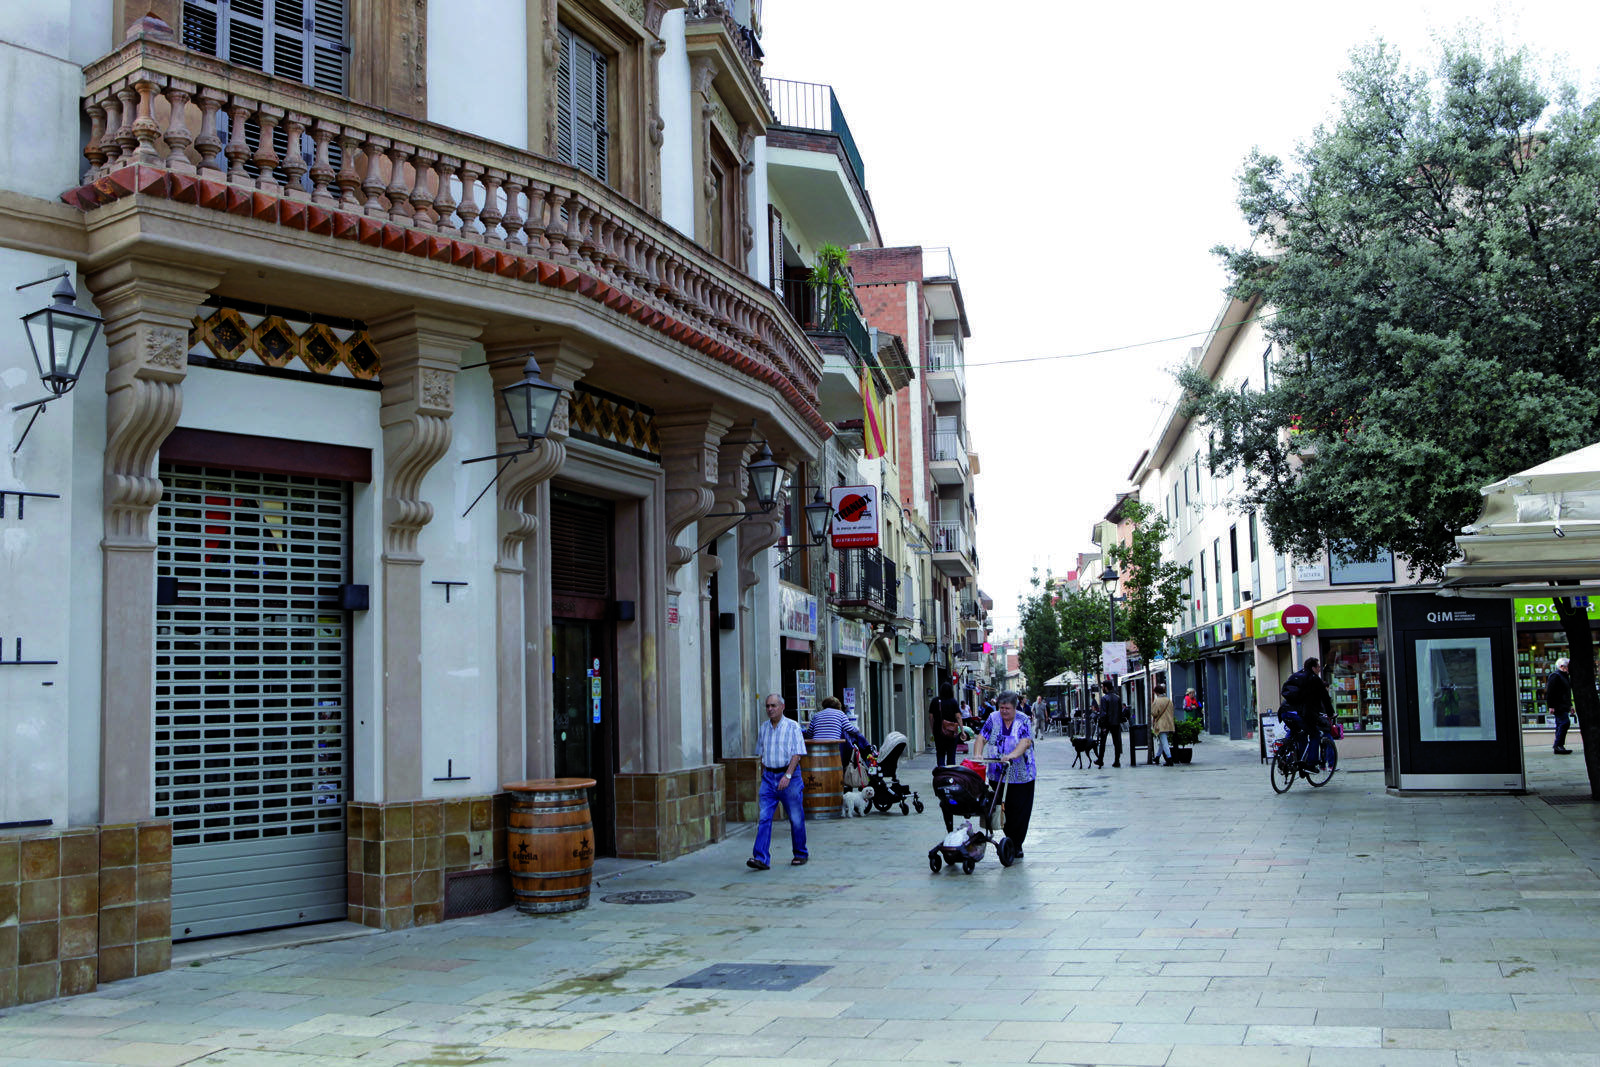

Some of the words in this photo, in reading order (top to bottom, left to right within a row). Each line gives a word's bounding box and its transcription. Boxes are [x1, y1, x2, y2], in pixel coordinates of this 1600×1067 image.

[834, 494, 872, 522] TITANLUX
[1525, 602, 1595, 614] ROCR
[1427, 611, 1453, 623] QiM
